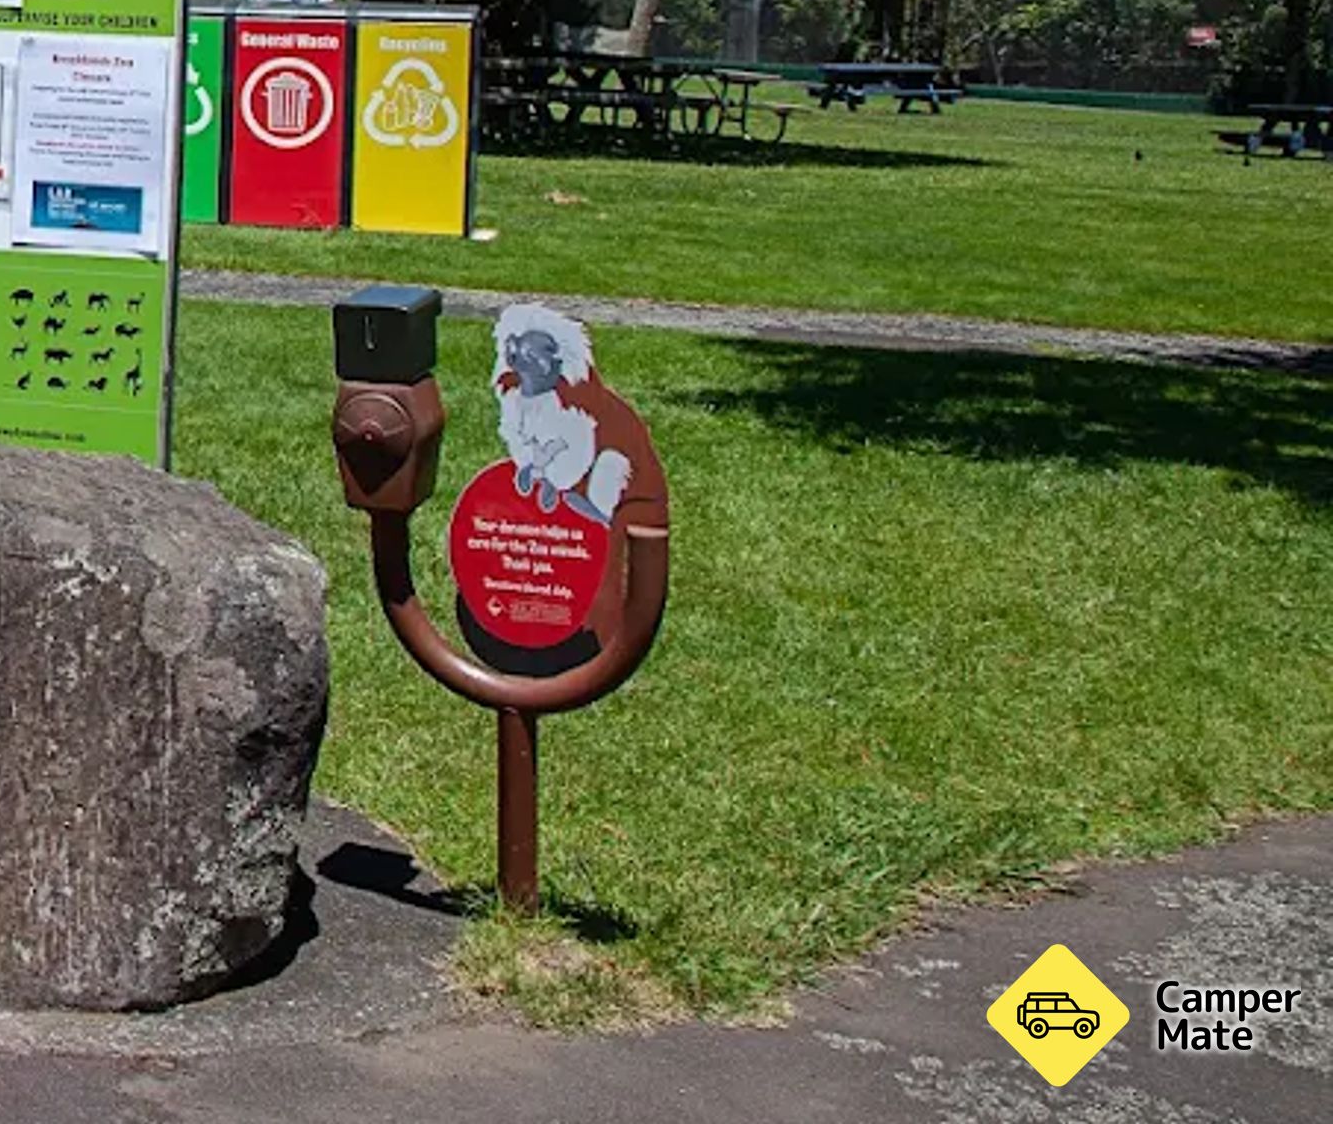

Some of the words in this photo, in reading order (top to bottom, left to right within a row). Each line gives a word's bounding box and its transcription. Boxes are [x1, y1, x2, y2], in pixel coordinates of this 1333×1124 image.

[241, 31, 294, 49] General
[297, 33, 340, 50] Waste
[472, 516, 497, 533] Your
[571, 528, 584, 540] us
[509, 539, 527, 552] the
[502, 553, 531, 571] Thank
